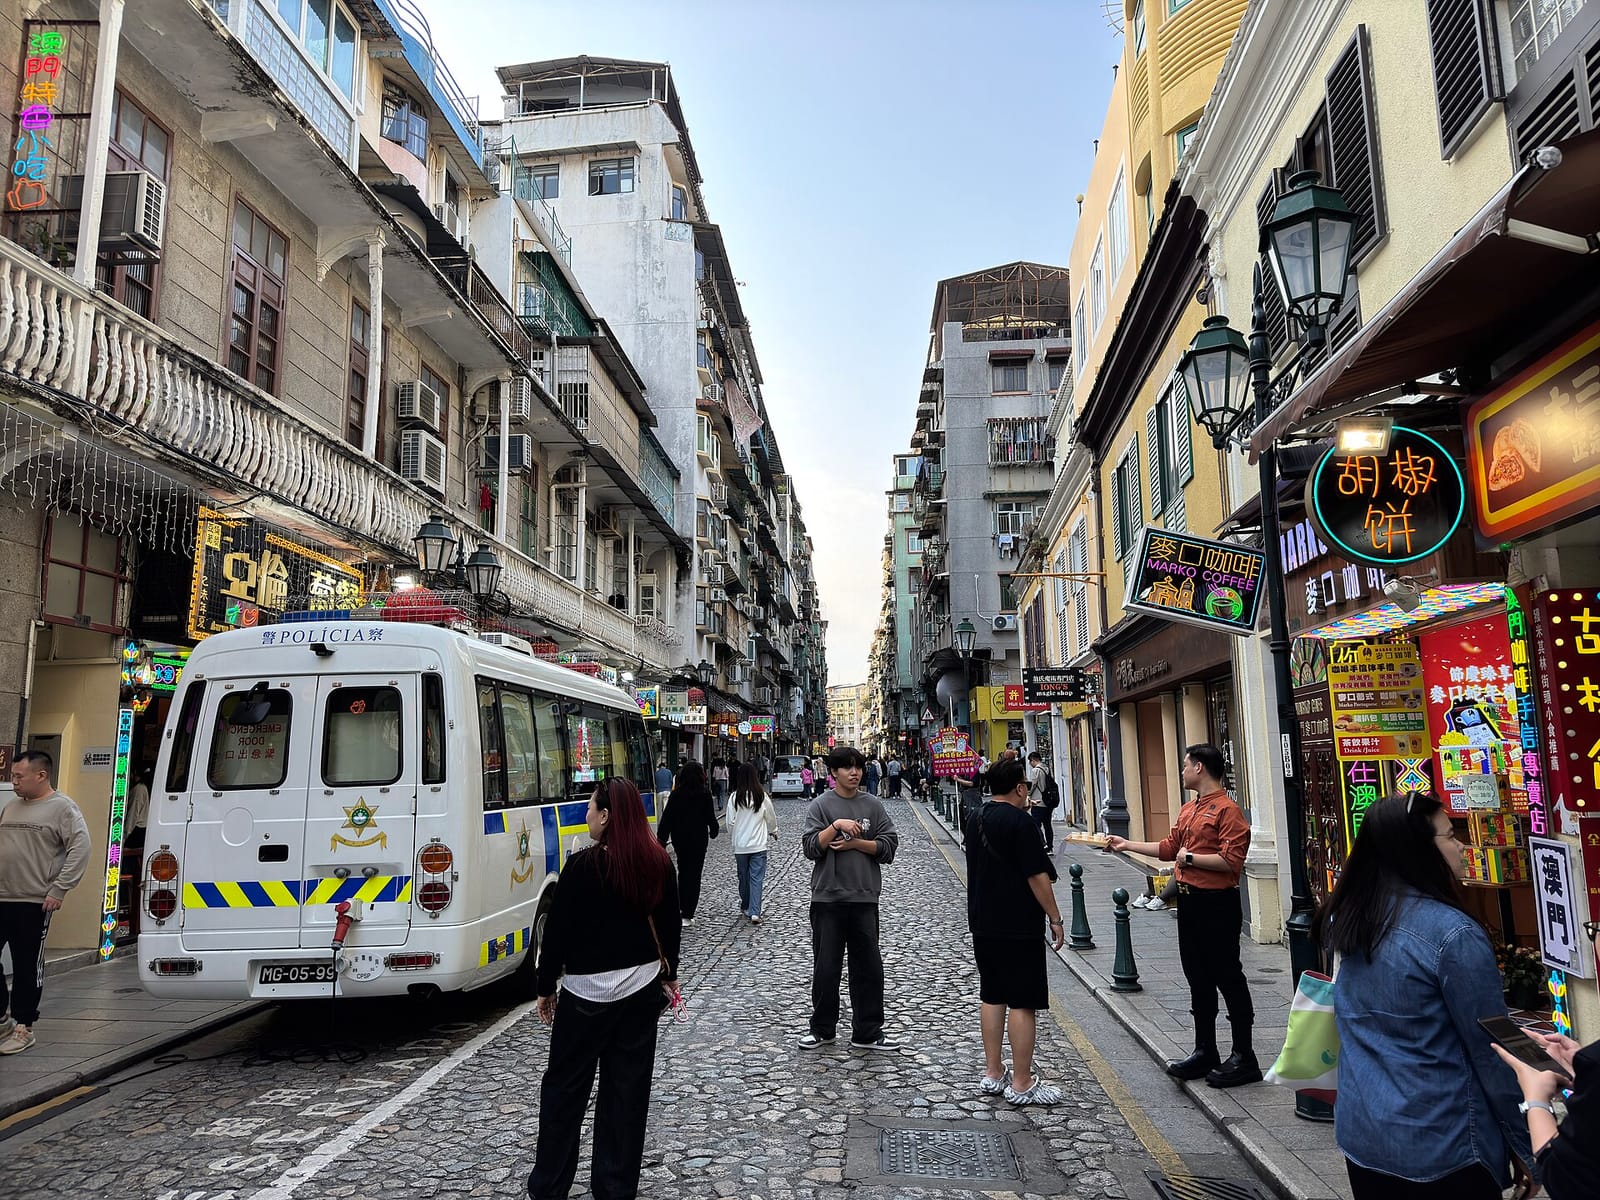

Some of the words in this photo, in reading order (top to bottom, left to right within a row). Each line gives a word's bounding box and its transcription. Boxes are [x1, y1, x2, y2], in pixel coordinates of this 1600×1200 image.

[13, 31, 66, 180] 澳門特色小吃
[1336, 447, 1437, 498] 胡椒
[1149, 536, 1261, 579] 麥口咖啡
[1147, 559, 1197, 578] MARKO
[1202, 570, 1254, 591] COFFEE
[262, 631, 277, 645] 警
[280, 627, 365, 644] POLÍCIA
[368, 628, 384, 641] 察
[261, 966, 335, 983] MG-05-99
